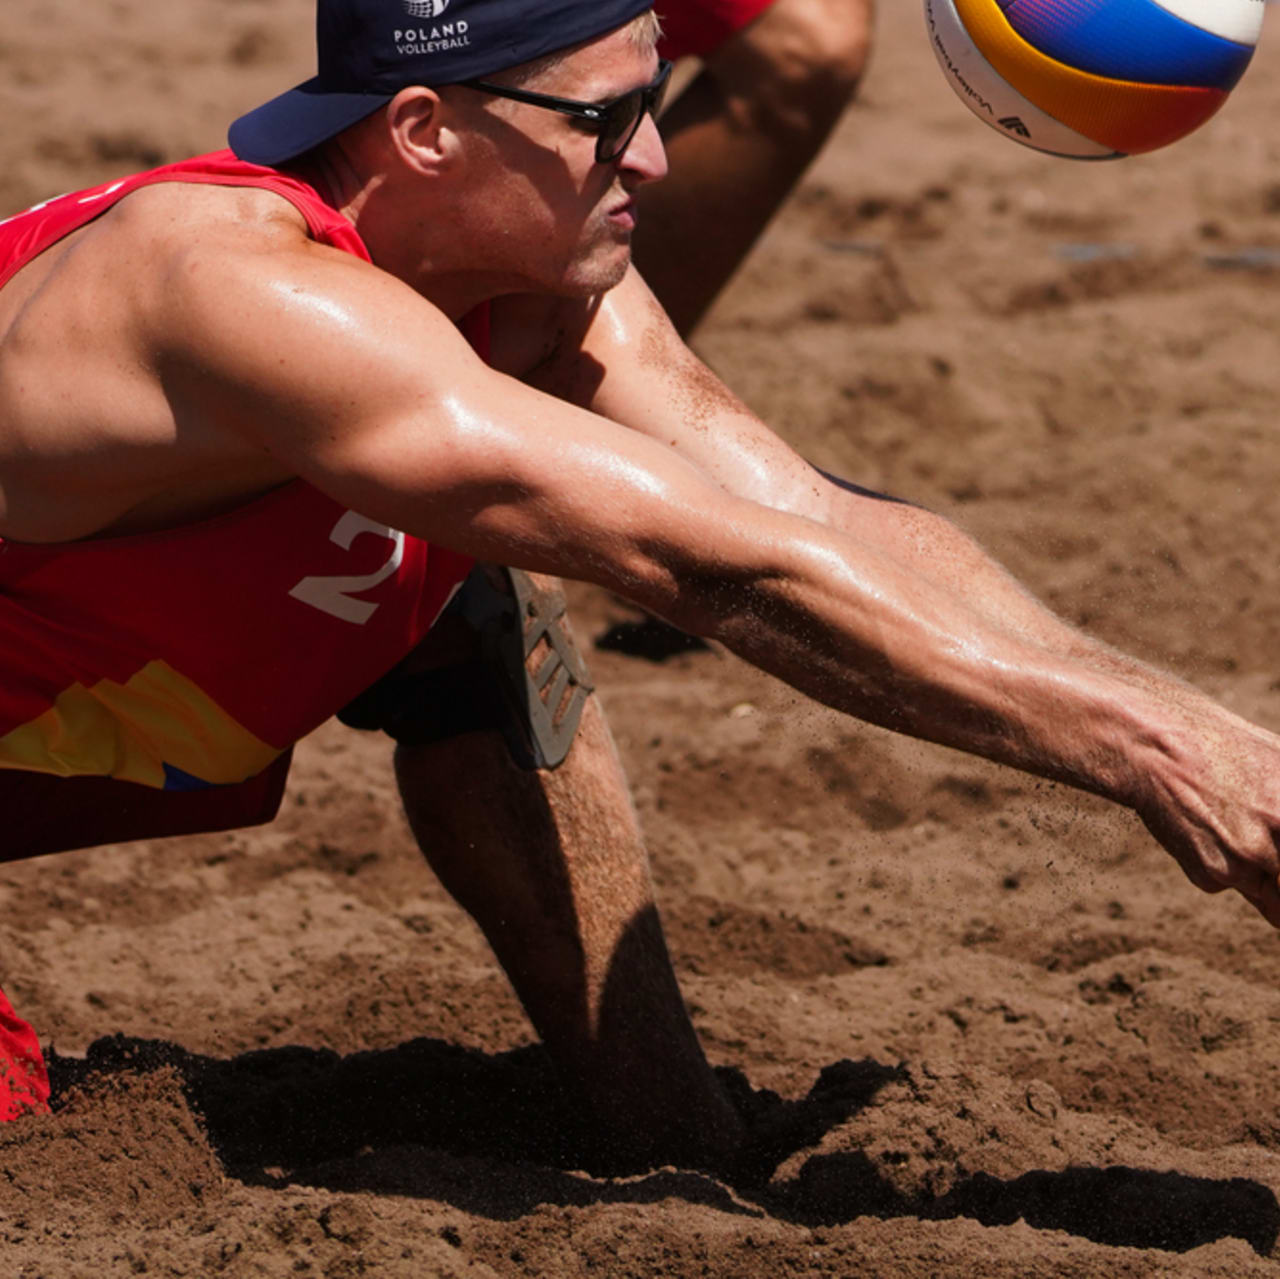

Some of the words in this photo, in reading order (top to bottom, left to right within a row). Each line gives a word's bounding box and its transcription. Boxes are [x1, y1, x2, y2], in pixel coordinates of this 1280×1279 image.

[393, 20, 469, 42] POLAND
[397, 35, 471, 55] VOLLEYBALL
[289, 509, 406, 625] 2
